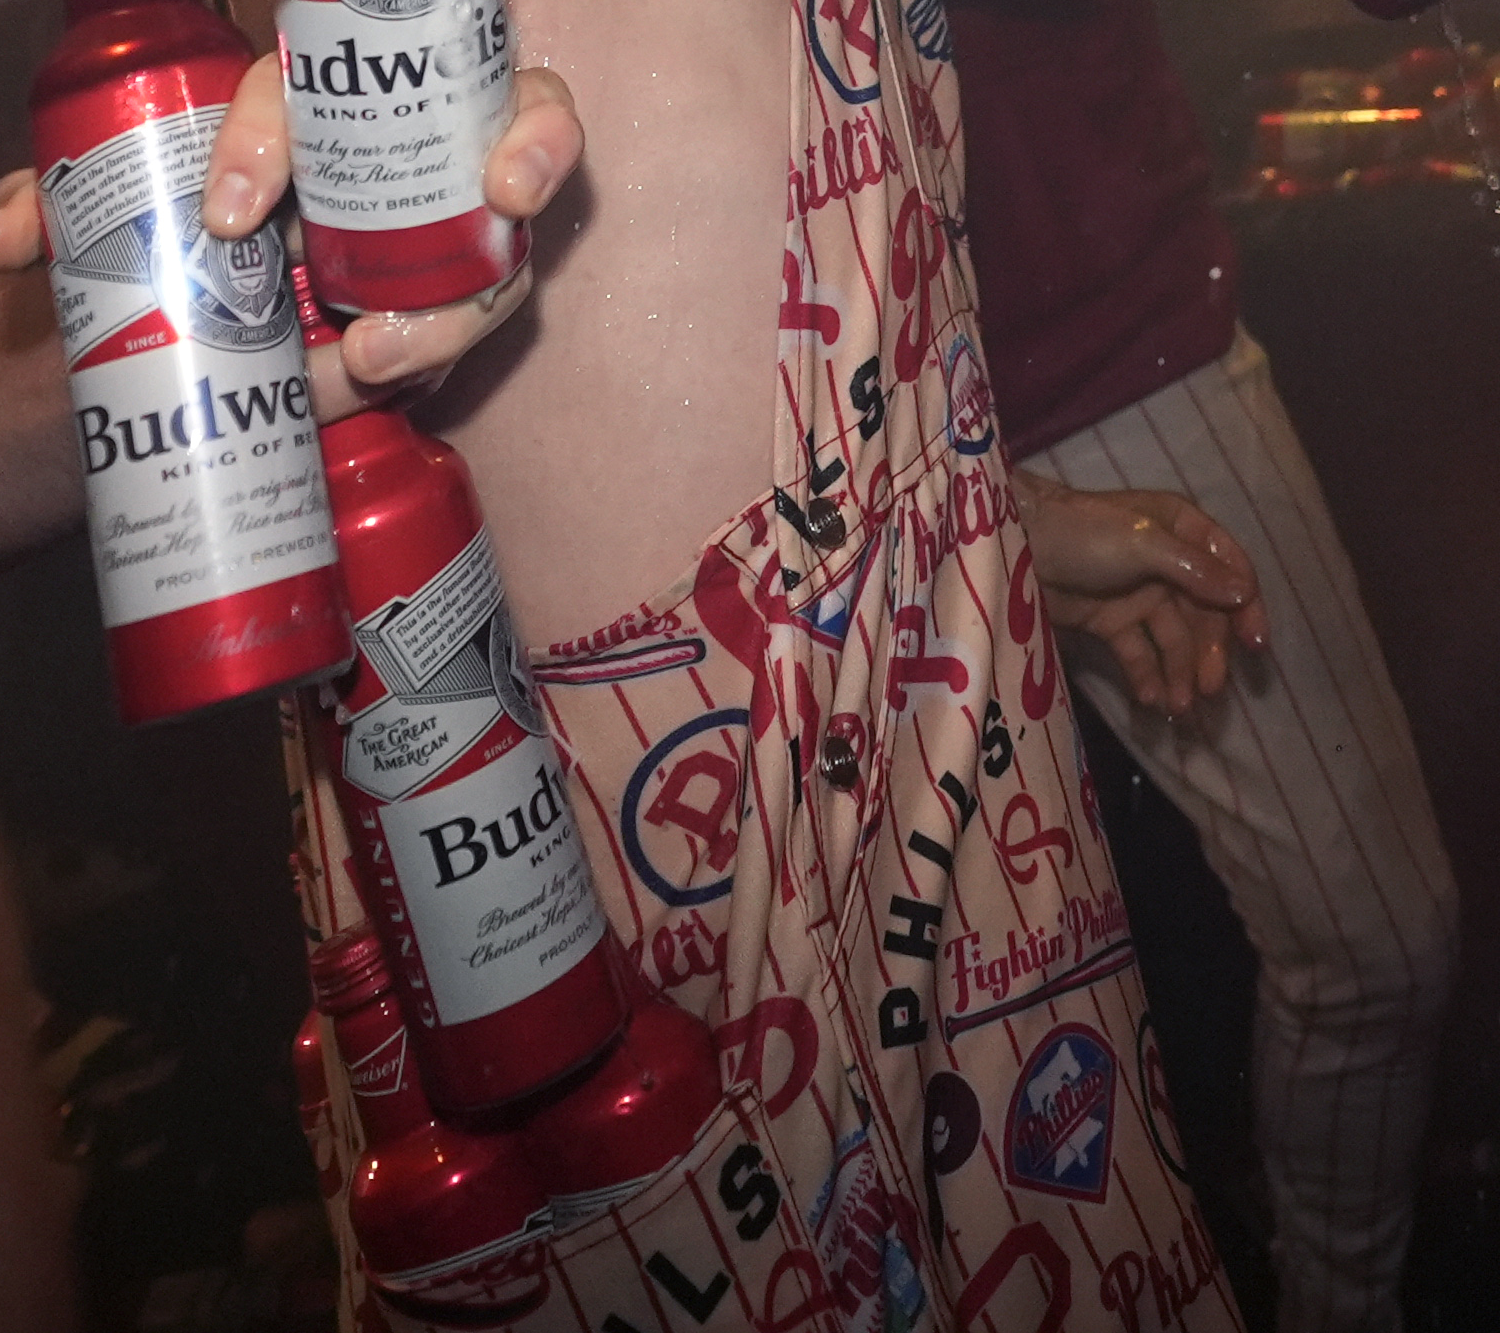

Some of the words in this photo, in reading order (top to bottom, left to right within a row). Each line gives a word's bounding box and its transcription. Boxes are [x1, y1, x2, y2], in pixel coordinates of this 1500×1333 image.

[312, 104, 378, 122] KING
[393, 98, 432, 118] OF
[328, 134, 350, 162] by
[352, 145, 384, 159] our
[87, 163, 105, 181] the
[97, 168, 126, 190] other
[412, 151, 451, 179] and
[74, 223, 95, 241] and
[124, 331, 167, 352] SINCE
[251, 437, 285, 459] OF
[398, 616, 418, 636] This
[417, 608, 428, 620] is
[426, 595, 443, 613] the
[442, 569, 471, 603] famous
[403, 635, 420, 650] by
[419, 620, 438, 637] any
[437, 597, 461, 621] other
[412, 617, 456, 659] exclusive
[419, 650, 440, 671] and
[438, 643, 448, 655] a
[359, 736, 388, 757] THE
[384, 715, 438, 749] GREAT
[483, 735, 516, 762] SINCE
[372, 731, 451, 773] AMERICAN
[529, 824, 572, 869] KING
[476, 881, 548, 939] Brewed
[461, 922, 540, 970] Choicest
